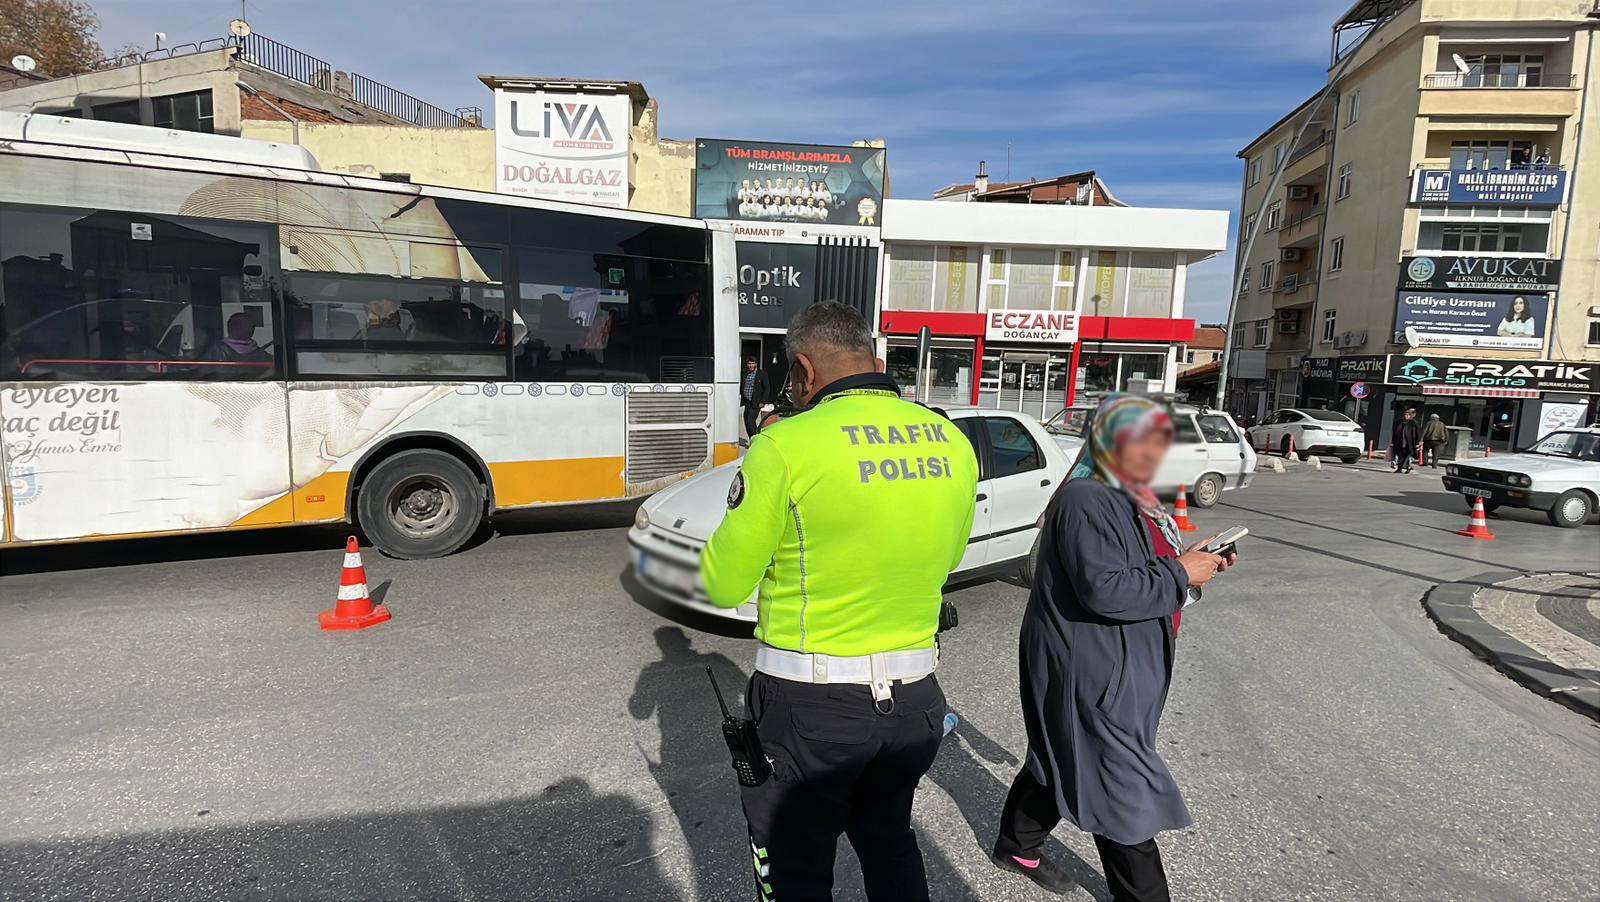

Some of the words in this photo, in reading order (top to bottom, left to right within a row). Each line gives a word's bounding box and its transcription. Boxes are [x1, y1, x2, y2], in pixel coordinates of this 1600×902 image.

[726, 146, 750, 159] TÜM
[753, 149, 852, 164] BRANŞLARIMIZLA
[503, 161, 621, 187] DOĞALGAZ
[748, 160, 828, 174] HİZMETİNİZDEYİZ
[1458, 172, 1484, 185] HALİL
[1487, 172, 1527, 185] İBRAHİM
[1529, 172, 1558, 188] ÖZTAŞ
[771, 228, 785, 237] TIP
[1446, 259, 1553, 276] AVUKAT
[740, 264, 801, 290] Optik
[738, 292, 748, 305] &
[753, 293, 785, 307] Lens
[1405, 296, 1447, 308] Cildiye
[1449, 297, 1496, 308] Uzmanı
[991, 313, 1074, 330] ECZANE
[1003, 330, 1060, 340] DOĞANÇAY
[1340, 358, 1384, 371] PRATİK
[1446, 362, 1592, 381] PRATİK
[1445, 375, 1526, 386] Sigorta
[48, 410, 120, 436] değil
[79, 439, 122, 455] Emre
